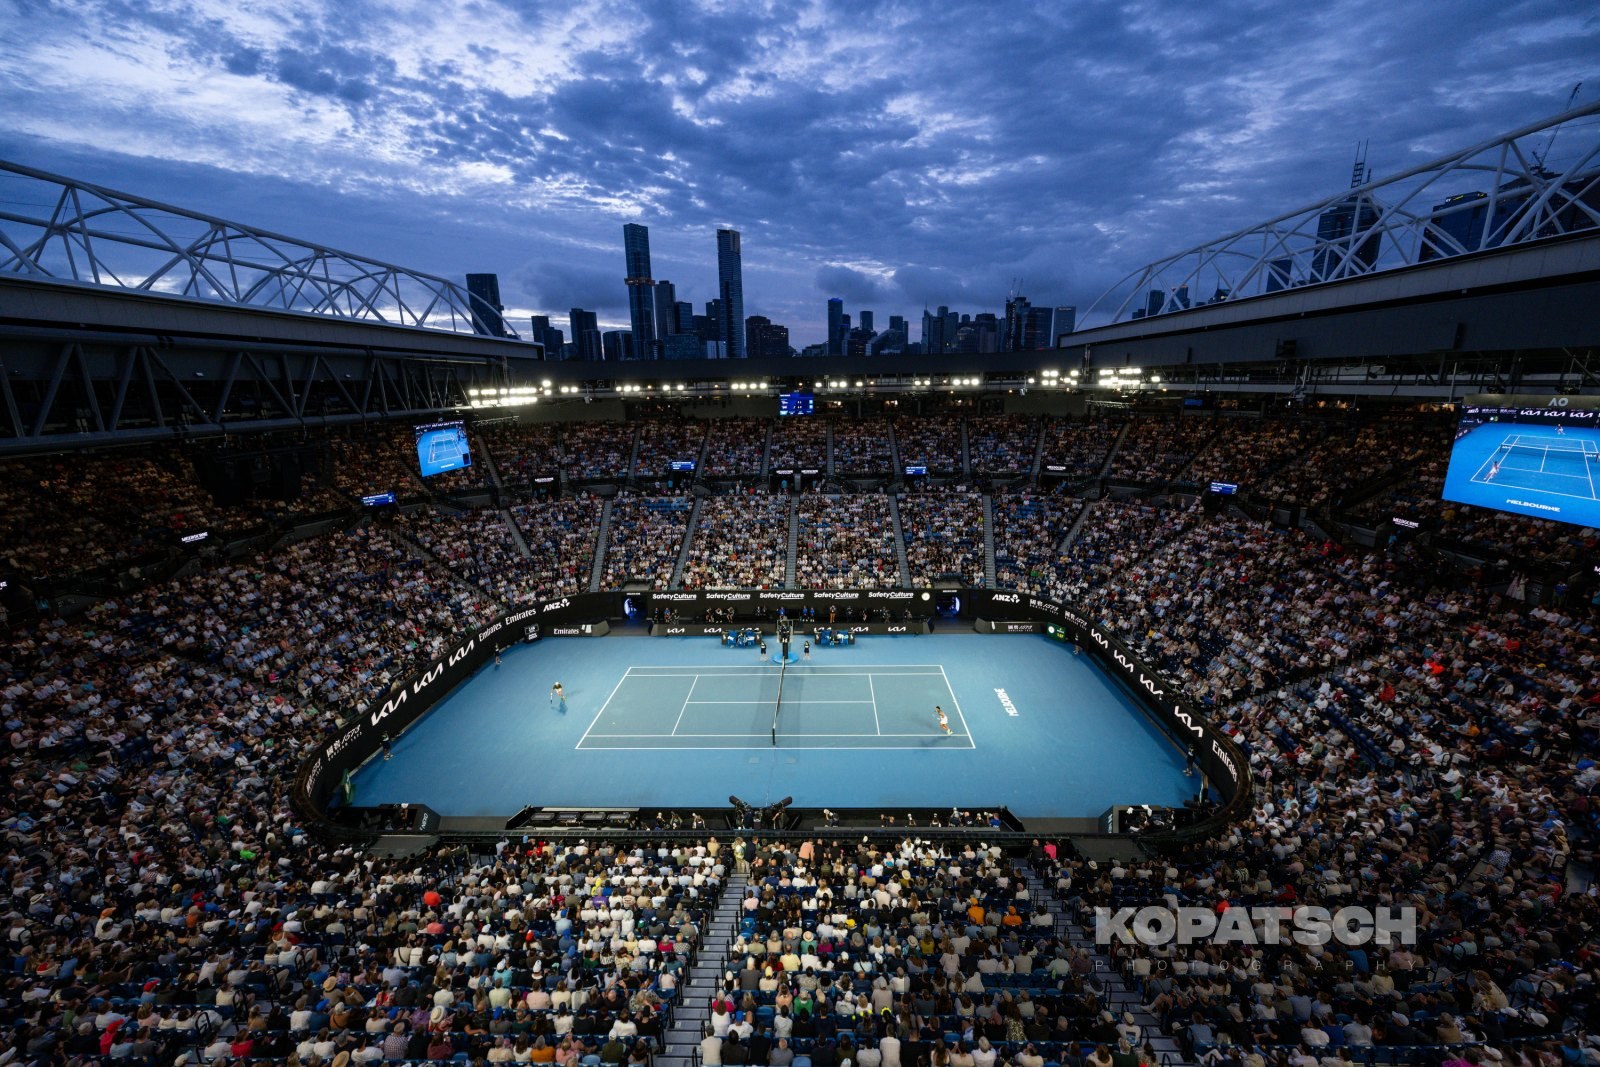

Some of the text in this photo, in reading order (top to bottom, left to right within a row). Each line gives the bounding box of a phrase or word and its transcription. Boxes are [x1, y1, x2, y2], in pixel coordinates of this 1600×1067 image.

[1506, 499, 1561, 513] MELBOURNE
[706, 592, 751, 600] SafetyCulture
[759, 592, 805, 600] SafetyCulture
[813, 592, 859, 600] SafetyCulture
[868, 591, 914, 599] SafetyCulture
[992, 594, 1011, 602] ANZ
[505, 608, 537, 625] Emirates
[478, 622, 503, 642] Emirates
[553, 627, 580, 635] Emirates
[1091, 628, 1109, 649] KIA
[449, 639, 475, 667] KIA
[1113, 650, 1134, 673] KIA
[413, 662, 443, 695] KIA
[1139, 673, 1164, 700] KIA
[371, 689, 408, 727] KIA
[1174, 706, 1203, 738] KIA
